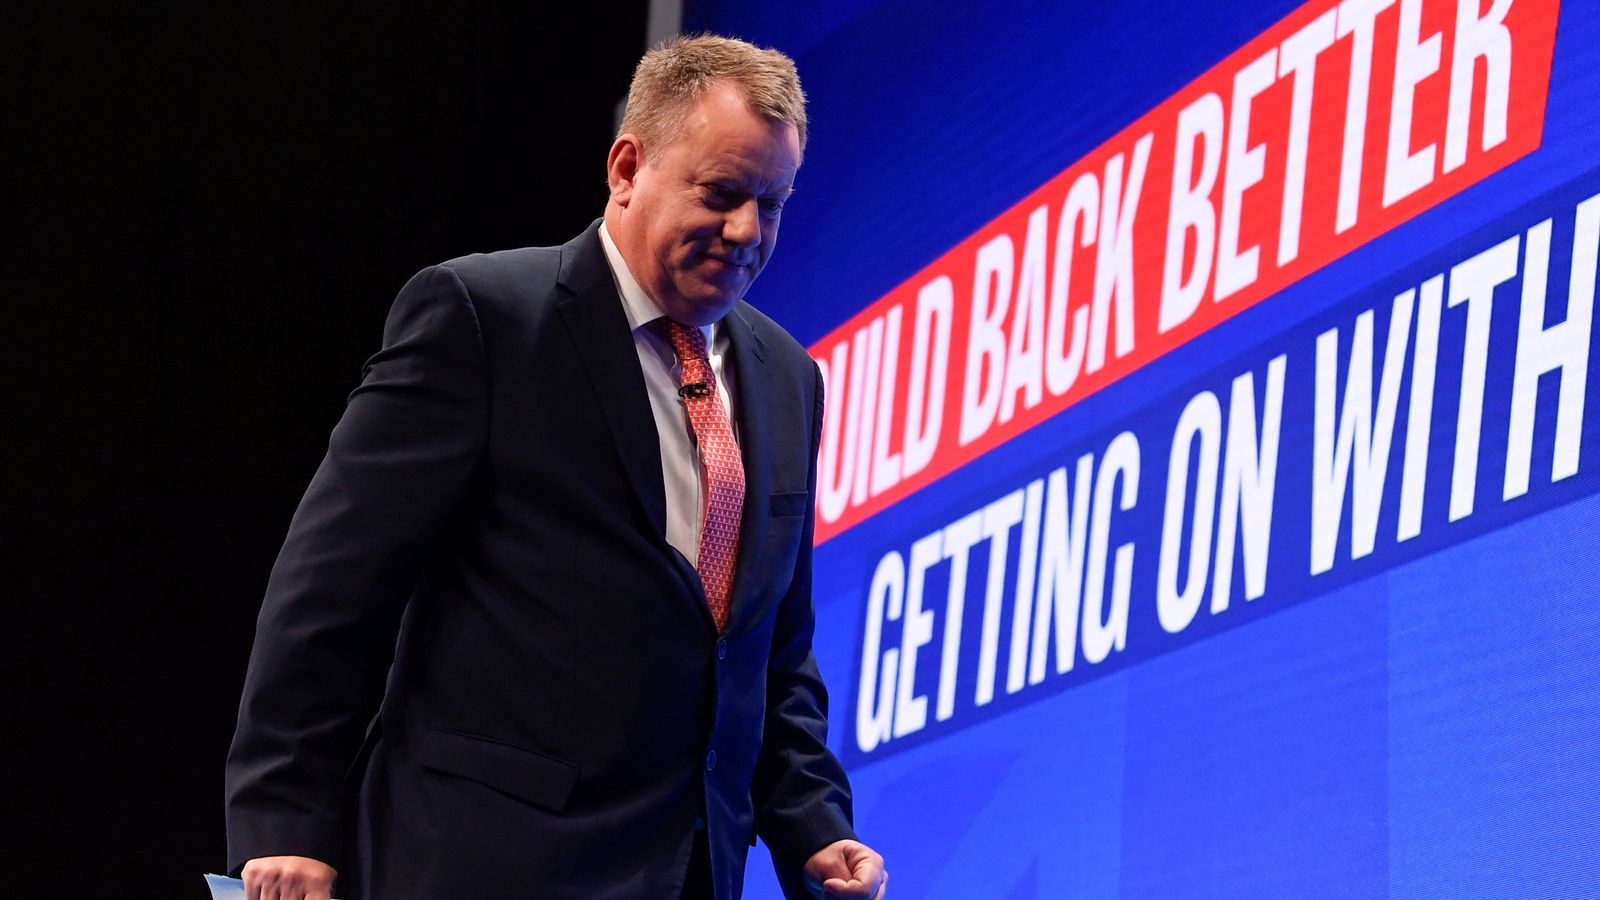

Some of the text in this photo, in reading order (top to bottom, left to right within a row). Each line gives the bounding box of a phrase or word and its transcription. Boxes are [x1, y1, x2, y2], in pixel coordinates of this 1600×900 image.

[856, 193, 1600, 752] GETTING ON WITH
[958, 132, 1154, 447] BACK
[1158, 0, 1516, 335] BETTER
